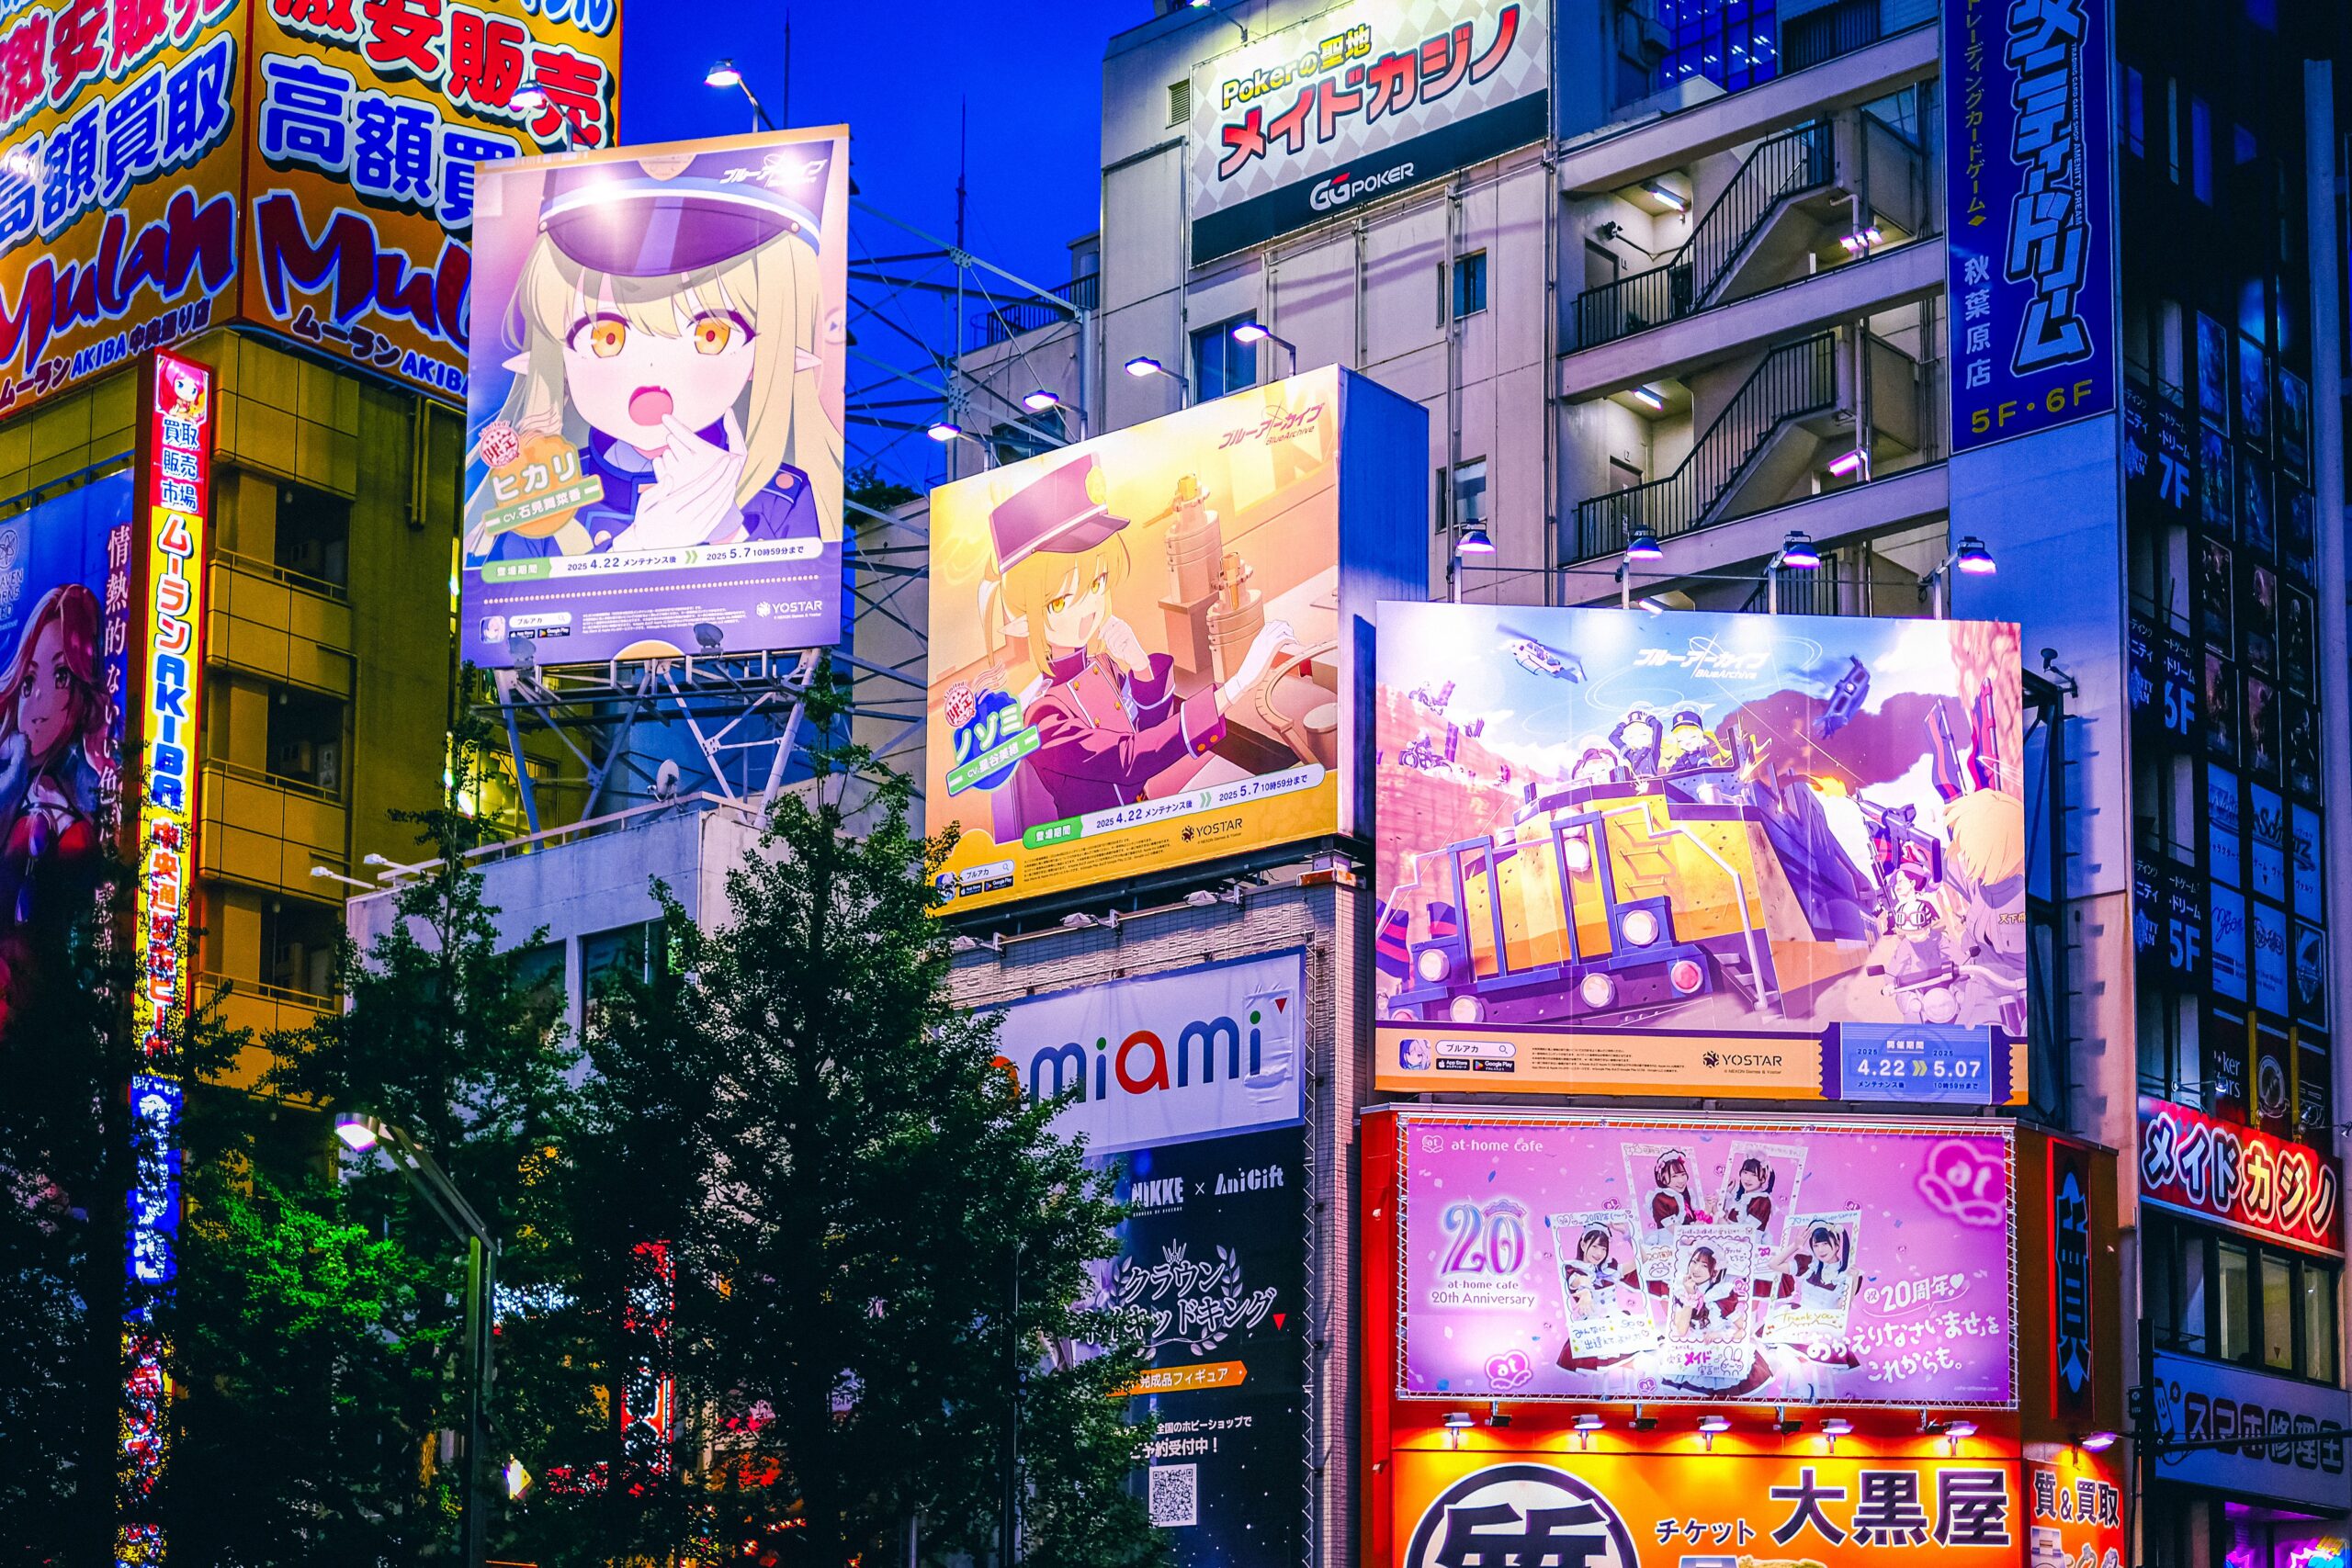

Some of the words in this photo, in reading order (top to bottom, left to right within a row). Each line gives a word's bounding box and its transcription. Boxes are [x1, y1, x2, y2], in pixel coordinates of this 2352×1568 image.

[1222, 24, 1372, 109] Pokerの聖地
[1218, 4, 1521, 181] メイドカジノ
[261, 55, 520, 228] 高額買
[2074, 142, 2082, 186] AMENITY
[2075, 188, 2083, 225] DREAM
[254, 189, 471, 357] Mul
[1964, 254, 1992, 390] 秋葉原店
[164, 417, 198, 446] 買取
[483, 433, 517, 464] 限定
[163, 450, 198, 480] 販売
[492, 452, 576, 501] ヒカリ
[2159, 452, 2190, 509] 7F
[162, 480, 198, 512] 市場
[567, 563, 587, 571] 2025
[590, 557, 620, 570] 4.22
[707, 552, 727, 561] 2025
[729, 547, 751, 558] 5.7
[517, 617, 543, 626] ブルアカ
[772, 600, 823, 613] YOSTAR
[1695, 669, 1758, 680] BlueArchive
[946, 690, 973, 724] 限定
[1219, 791, 1238, 801] 2025
[1240, 782, 1260, 796] 5.7
[1261, 774, 1307, 792] 10時59分まで
[1096, 818, 1114, 828] 2025
[1116, 809, 1142, 824] 4.22
[1145, 800, 1193, 818] メンテナンス後
[1196, 818, 1242, 838] YOSTAR
[967, 869, 989, 880] ブルアカ
[2169, 918, 2200, 972] 5F
[1446, 1043, 1479, 1054] ブルアカ
[1722, 1054, 1782, 1066] YOSTAR
[1858, 1058, 1905, 1077] 4.22
[1933, 1060, 1981, 1077] 5.07
[1451, 1140, 1510, 1151] at-home
[1514, 1139, 1544, 1152] cafe
[1131, 1177, 1183, 1208] NIKKE
[1215, 1165, 1284, 1195] AniGift
[2144, 1116, 2334, 1235] メイドカジノ
[1440, 1202, 1526, 1278] 20
[1125, 1259, 1226, 1303] クラウン
[1447, 1278, 1493, 1290] at-home
[1496, 1279, 1520, 1290] cafe
[1431, 1292, 1459, 1304] 20th
[1463, 1292, 1535, 1307] Anniversary
[1868, 1346, 1962, 1383] これからも。
[1157, 1416, 1252, 1435] 全国のホビーショップで
[1770, 1467, 2011, 1547] 大黒屋
[1656, 1517, 1756, 1545] チケット
